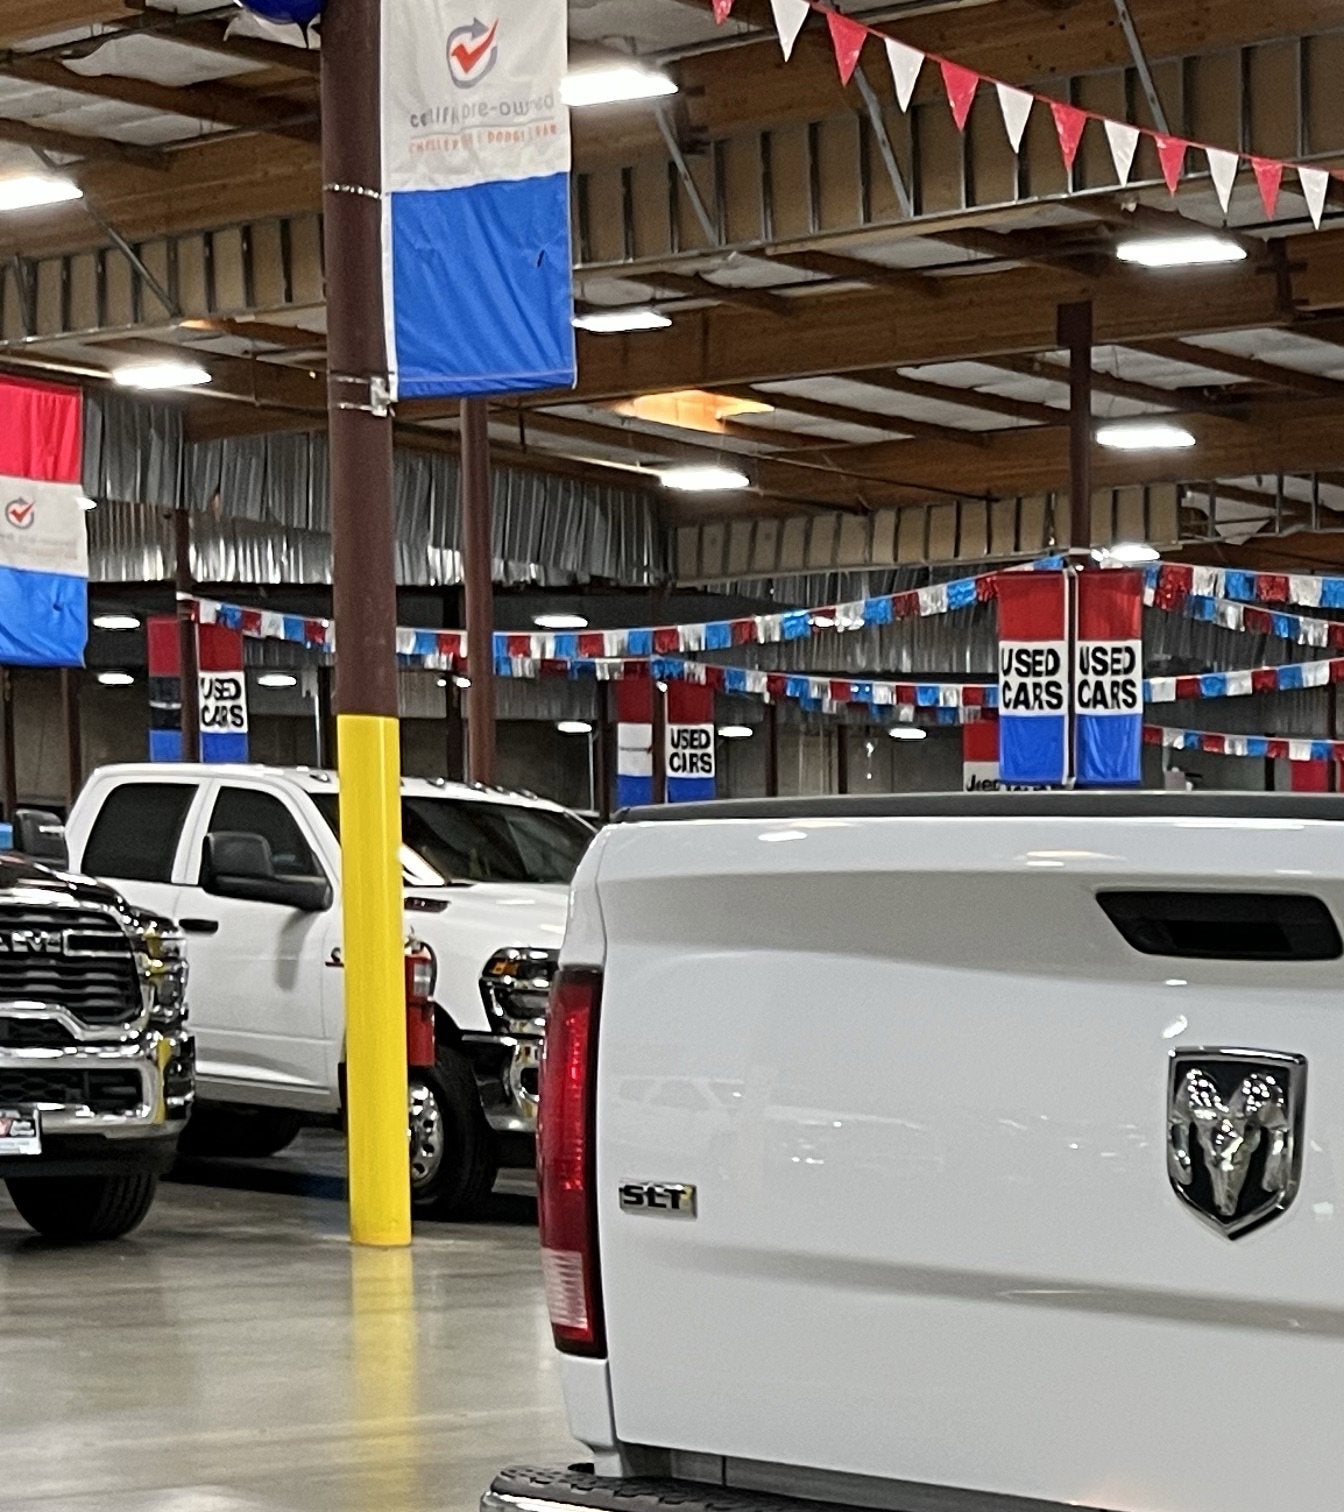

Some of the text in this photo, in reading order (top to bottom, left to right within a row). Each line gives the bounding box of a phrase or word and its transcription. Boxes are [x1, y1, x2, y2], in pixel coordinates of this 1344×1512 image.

[1001, 648, 1061, 678] USED
[1079, 645, 1136, 676] USED
[200, 677, 243, 701] USED
[1001, 680, 1063, 710] CARS
[1077, 679, 1137, 710] CARS
[670, 728, 711, 750] USED
[620, 1184, 688, 1210] SLT
